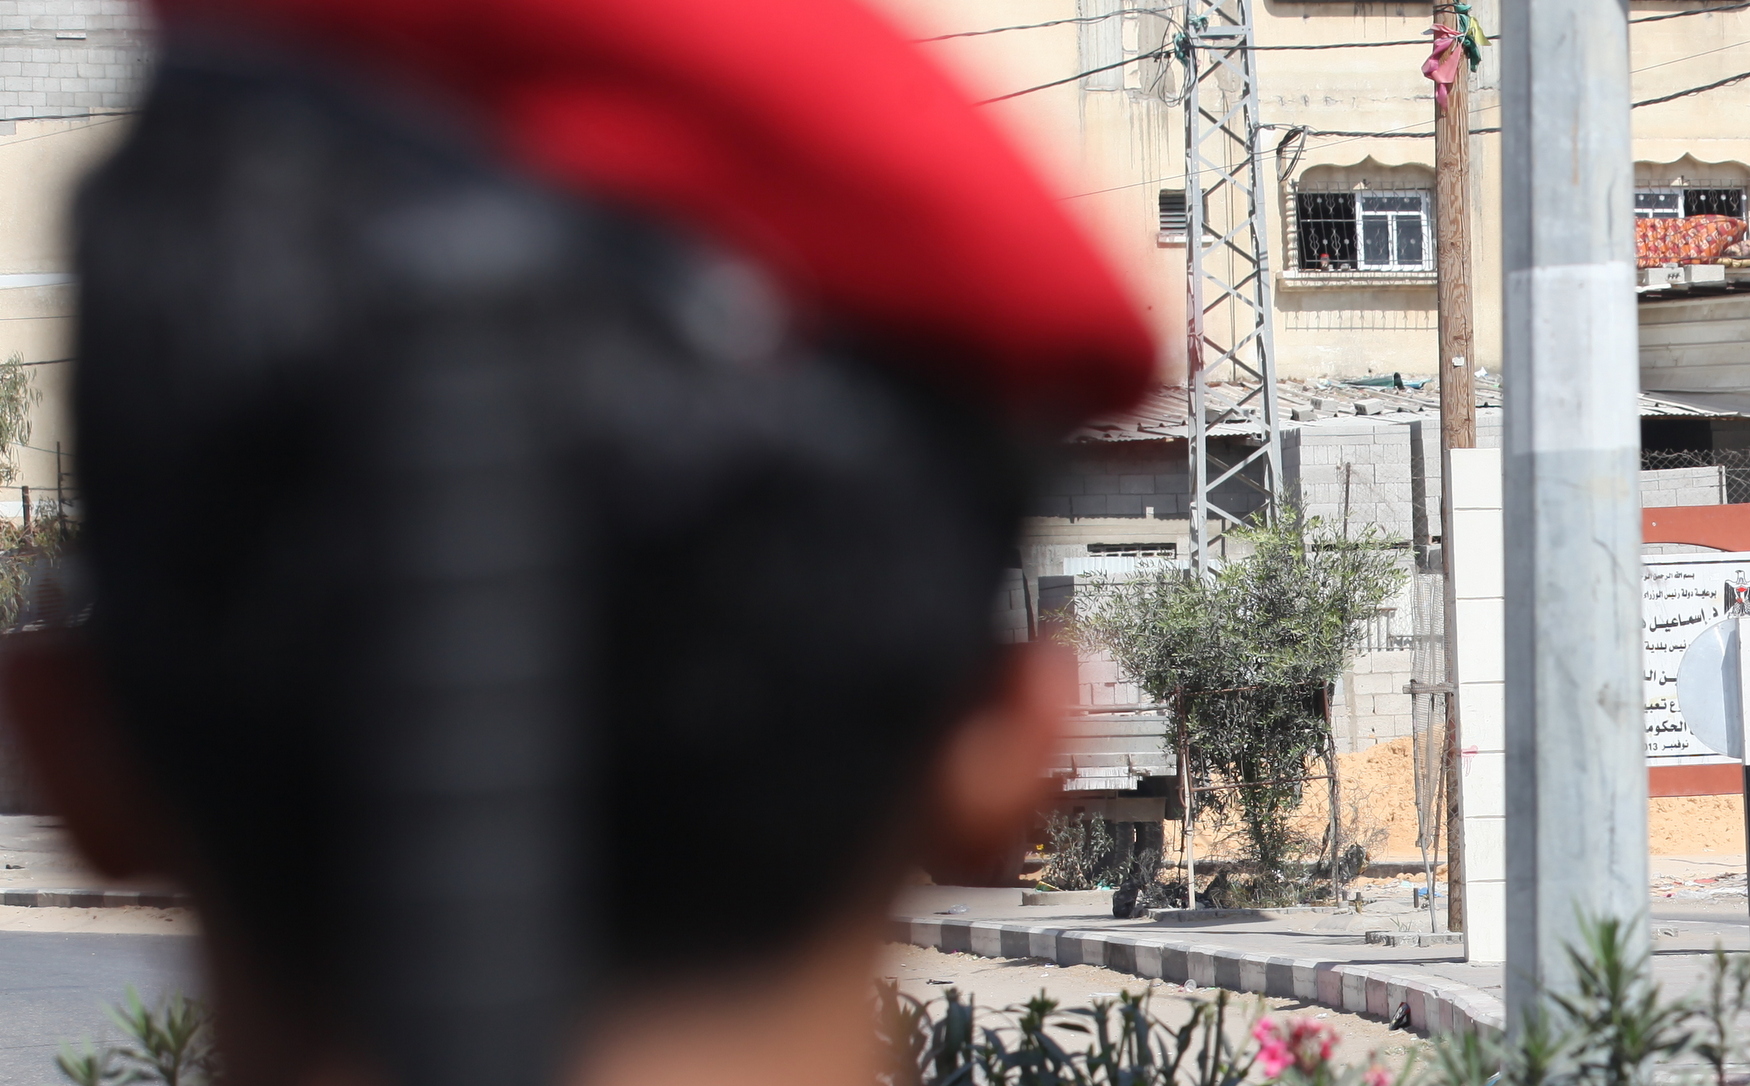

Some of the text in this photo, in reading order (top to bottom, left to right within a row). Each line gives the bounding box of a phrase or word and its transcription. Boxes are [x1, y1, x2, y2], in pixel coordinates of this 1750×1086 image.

[1653, 572, 1673, 581] الرحمن
[1674, 571, 1683, 579] الله
[1683, 572, 1695, 580] بسم
[1643, 587, 1717, 601] برعاية دولة رئيس الوزراء
[1649, 607, 1708, 633] إسماعيل
[1644, 639, 1691, 653] ئيس بلدية
[1643, 697, 1667, 714] تعبي
[1644, 720, 1687, 736] الحكوم
[1661, 739, 1689, 751] نوفمبر
